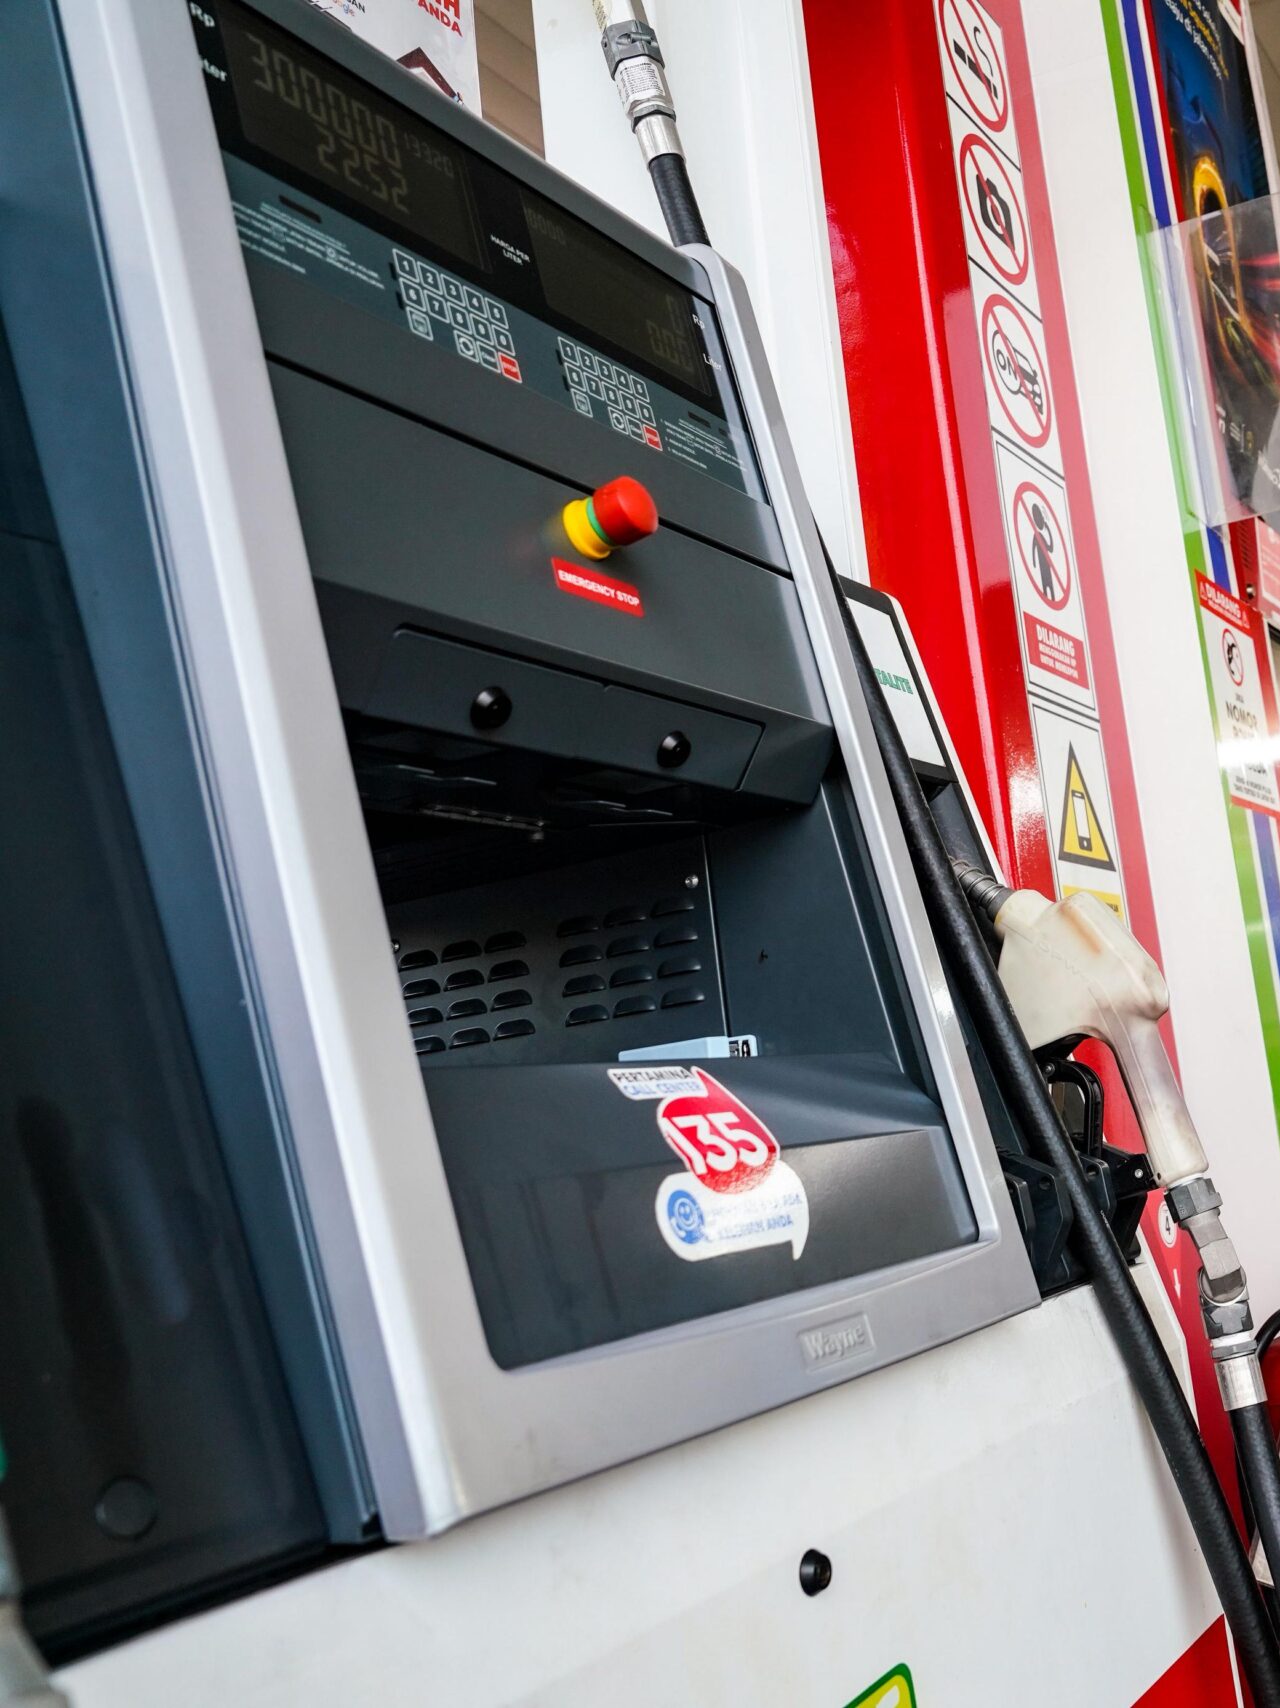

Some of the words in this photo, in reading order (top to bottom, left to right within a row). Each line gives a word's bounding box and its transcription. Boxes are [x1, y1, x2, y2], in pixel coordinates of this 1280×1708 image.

[190, 2, 215, 27] Rp
[418, 0, 464, 37] ANDA
[201, 60, 228, 82] ter
[490, 234, 516, 254] HARGA
[515, 248, 531, 263] PER
[502, 250, 524, 266] LITER
[557, 569, 616, 599] EMERGENCY
[616, 590, 640, 607] STOP
[1035, 624, 1075, 657] DILARANG
[872, 668, 914, 695] TALITE
[612, 1069, 692, 1083] PERTAMINA
[623, 1083, 657, 1096] CALL
[656, 1081, 702, 1094] CENTER
[663, 1112, 768, 1175] 135
[802, 1325, 865, 1360] Wayne
